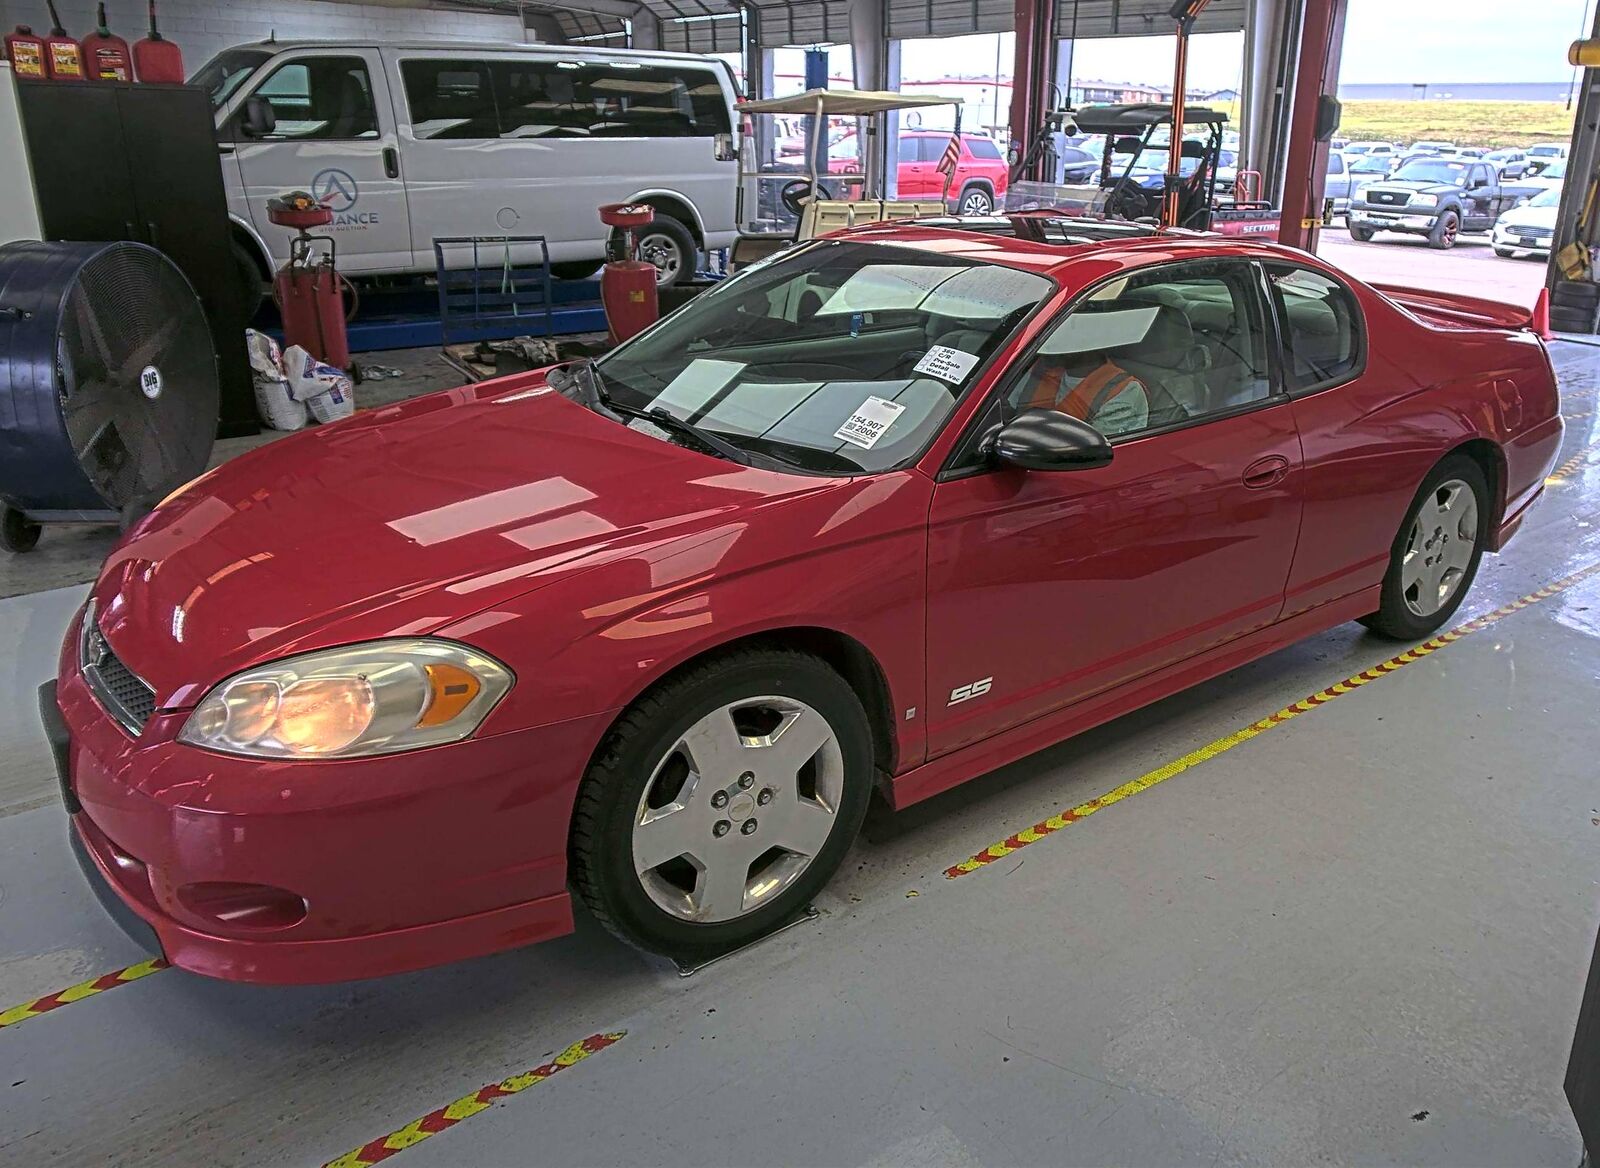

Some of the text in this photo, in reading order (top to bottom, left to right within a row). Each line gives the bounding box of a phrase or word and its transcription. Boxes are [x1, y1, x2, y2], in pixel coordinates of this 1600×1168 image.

[328, 212, 379, 226] IANCE
[1243, 223, 1276, 233] SECTOR
[929, 362, 950, 372] Detail
[933, 357, 960, 369] Pre-Sale
[143, 371, 158, 387] BIG
[926, 367, 942, 375] Wash
[949, 374, 960, 382] Vac
[850, 415, 885, 431] 154,907
[855, 425, 878, 438] 2006
[946, 676, 993, 708] SS
